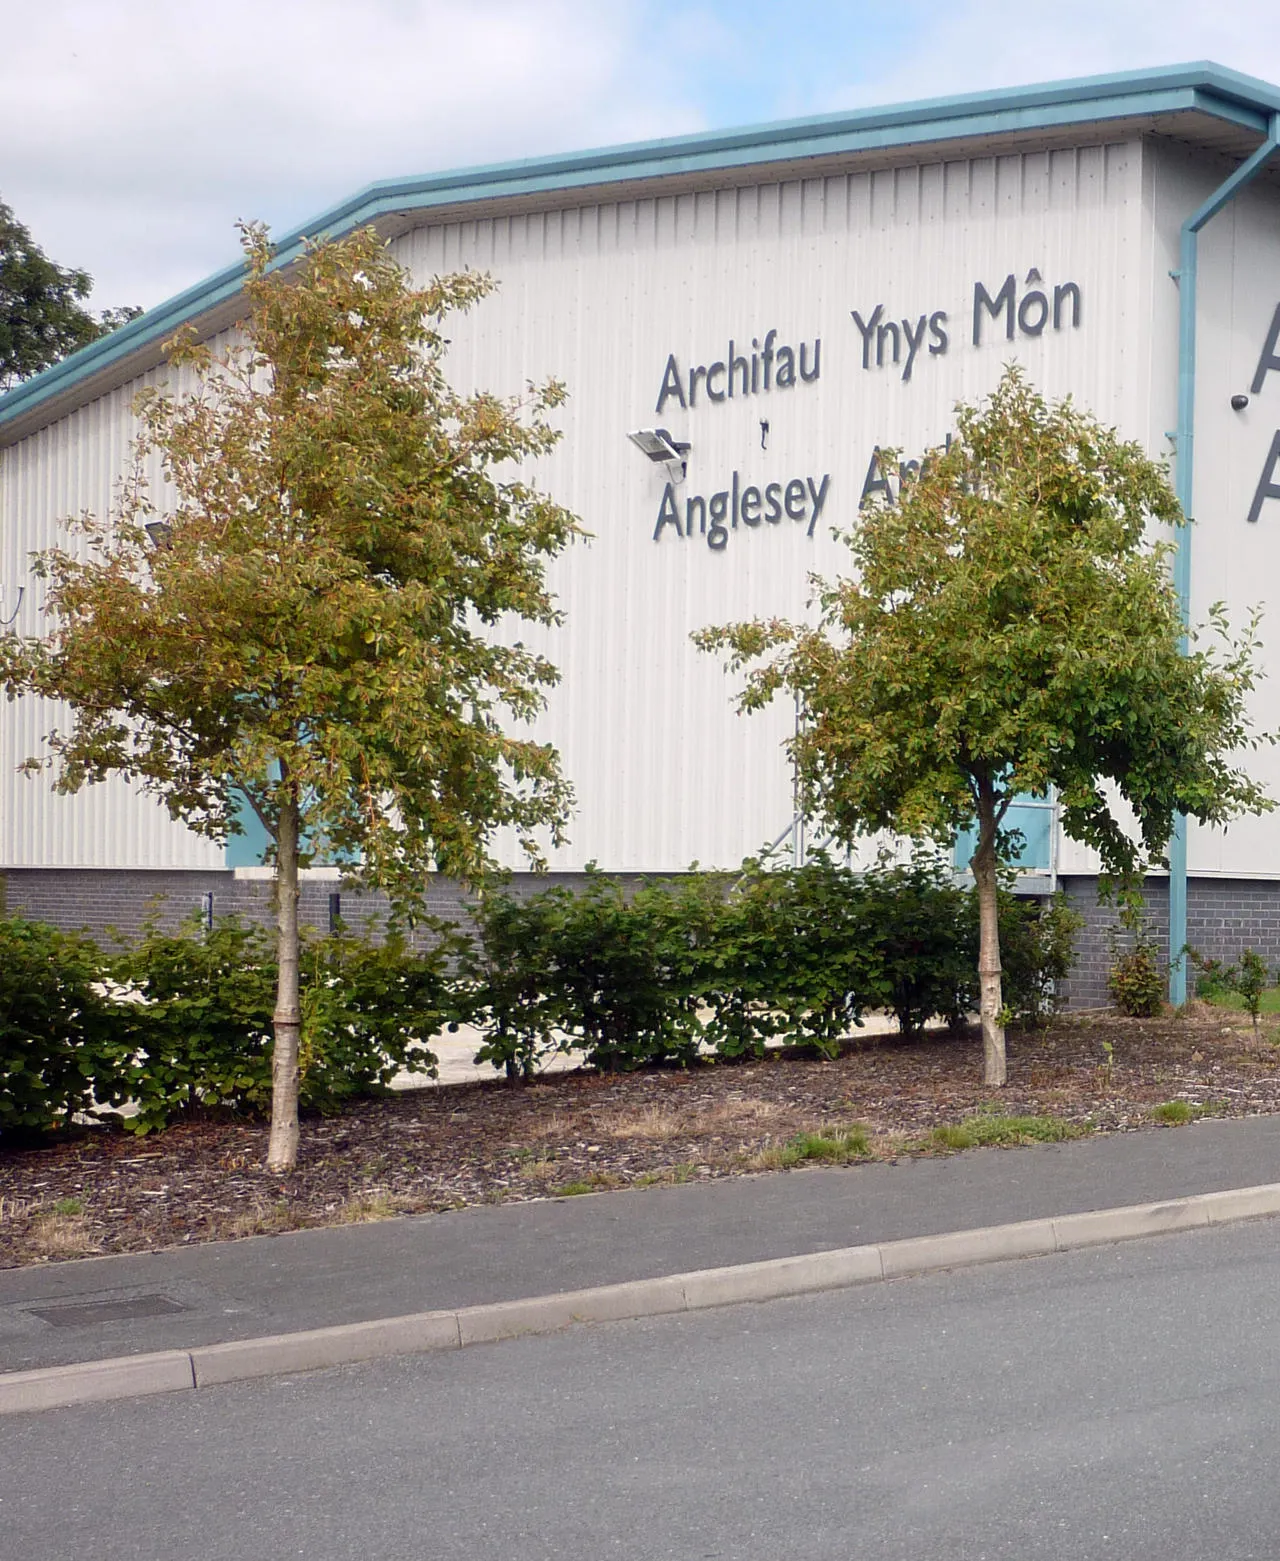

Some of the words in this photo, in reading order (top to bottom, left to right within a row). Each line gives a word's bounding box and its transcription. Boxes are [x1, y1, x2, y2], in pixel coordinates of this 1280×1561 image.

[654, 328, 822, 414] Archifau
[850, 304, 948, 381] Ynys
[972, 268, 1081, 347] Môn
[652, 470, 830, 551] Anglesey
